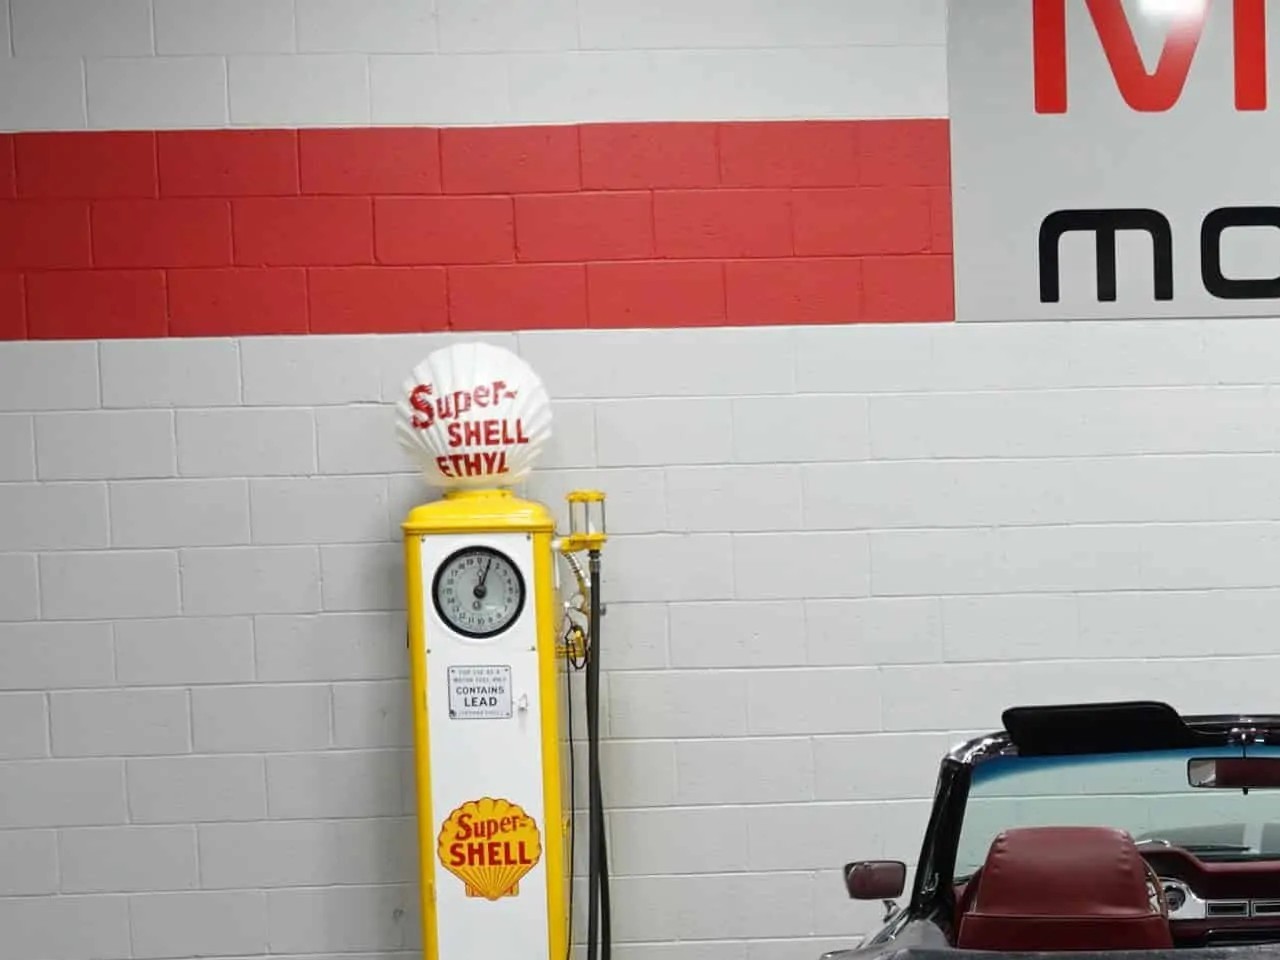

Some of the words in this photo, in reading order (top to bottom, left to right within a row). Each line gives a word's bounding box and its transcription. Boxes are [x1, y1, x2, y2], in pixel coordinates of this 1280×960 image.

[447, 418, 529, 448] SHELL
[436, 451, 510, 478] ETHYL
[455, 686, 505, 695] CONTAINS
[464, 696, 498, 707] LEAD
[449, 841, 532, 867] SHELL
